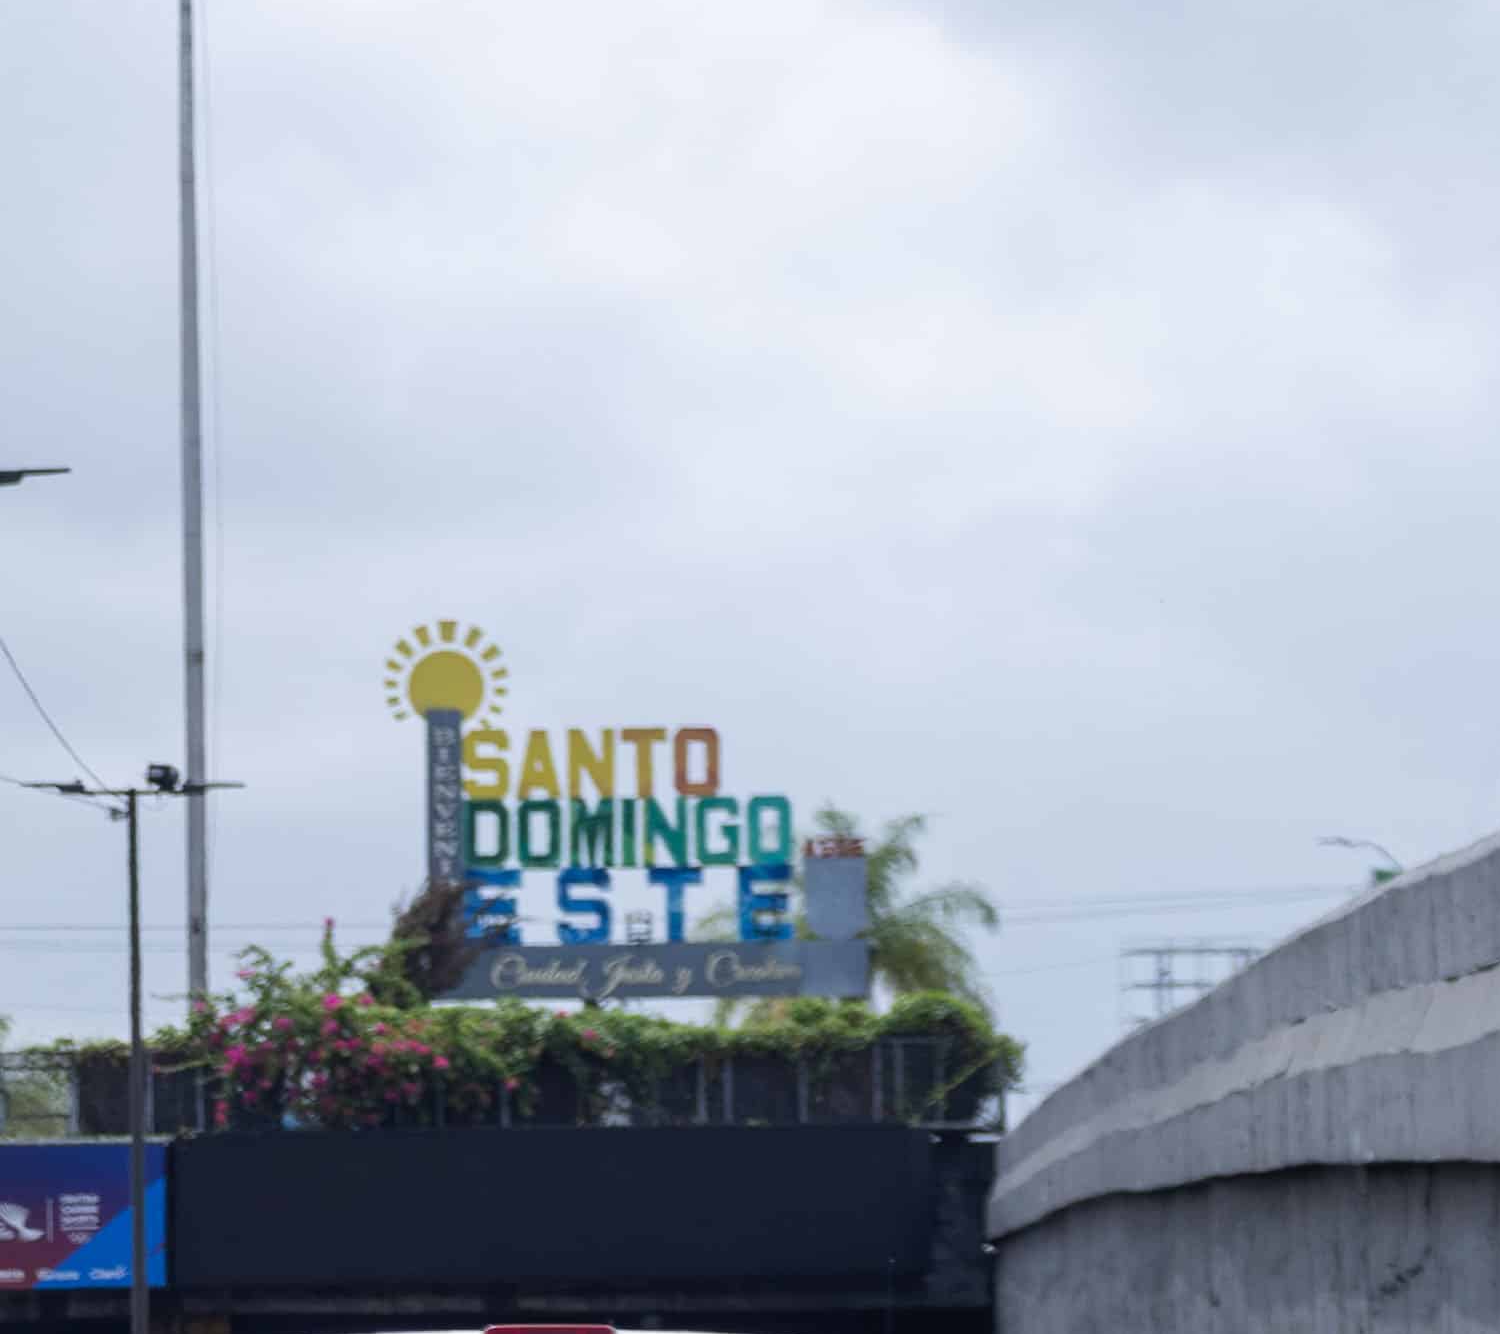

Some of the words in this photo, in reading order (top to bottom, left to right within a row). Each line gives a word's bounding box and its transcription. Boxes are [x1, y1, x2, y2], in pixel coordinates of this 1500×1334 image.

[431, 725, 458, 875] BIENVENI
[463, 727, 720, 800] SANTO
[463, 797, 793, 868] DOMINGO
[463, 864, 795, 946] ESTE
